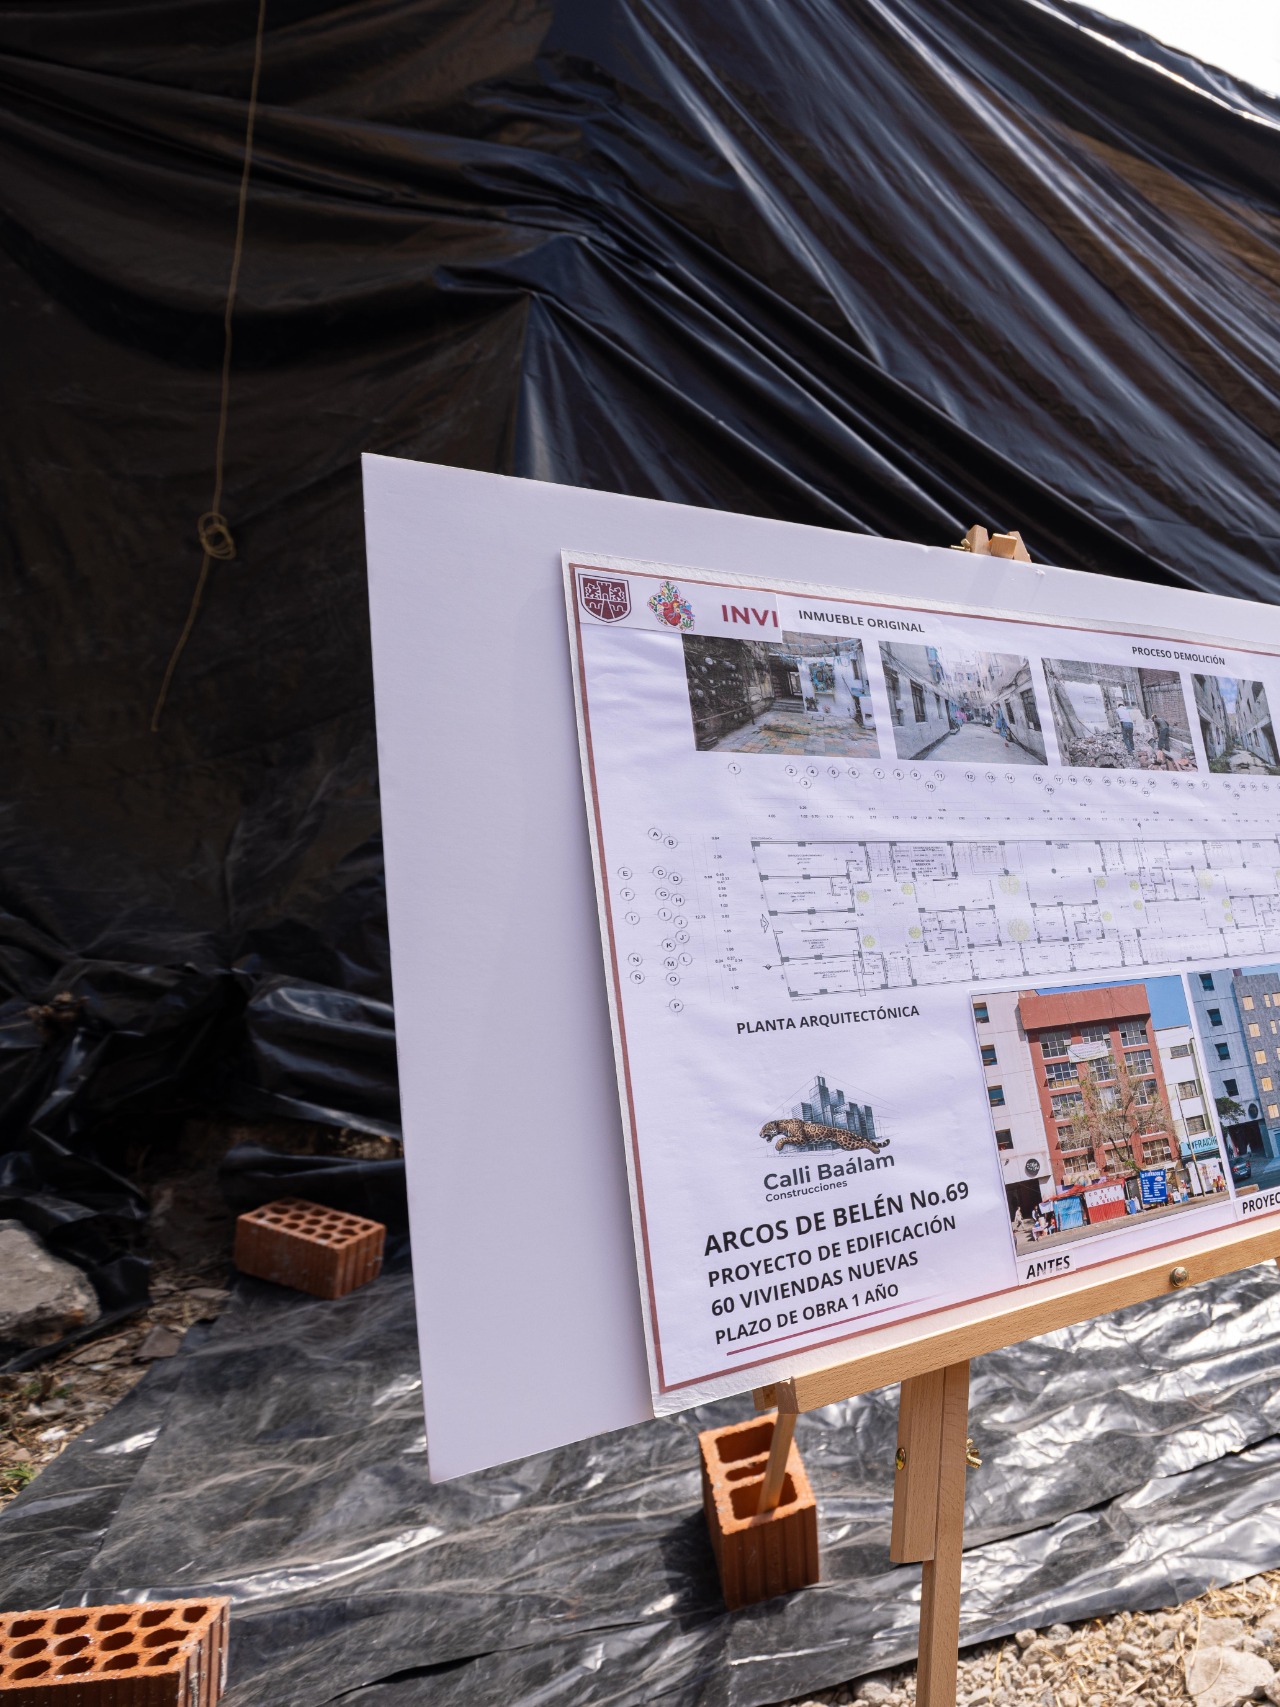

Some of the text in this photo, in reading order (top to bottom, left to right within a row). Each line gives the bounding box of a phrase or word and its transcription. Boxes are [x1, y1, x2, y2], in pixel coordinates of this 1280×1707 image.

[721, 604, 779, 628] INVI
[798, 609, 925, 634] INMUEBLE ORIGINAL
[1131, 646, 1226, 665] PROCESO DEMOLICIÓN
[736, 1004, 920, 1034] PLANTA ARQUITECTÓNICA
[763, 1154, 895, 1191] Calli Baálam
[765, 1179, 848, 1202] Construcciones
[704, 1181, 970, 1256] ARCOS DE BELÉN No.69
[708, 1214, 957, 1287] PROYECTO DE EDIFICACIÓN
[1026, 1255, 1071, 1280] ANTES
[711, 1250, 919, 1316] 60 VIVIENDAS NUEVAS
[715, 1283, 900, 1345] PLAZO DE OBRA 1 AÑO
